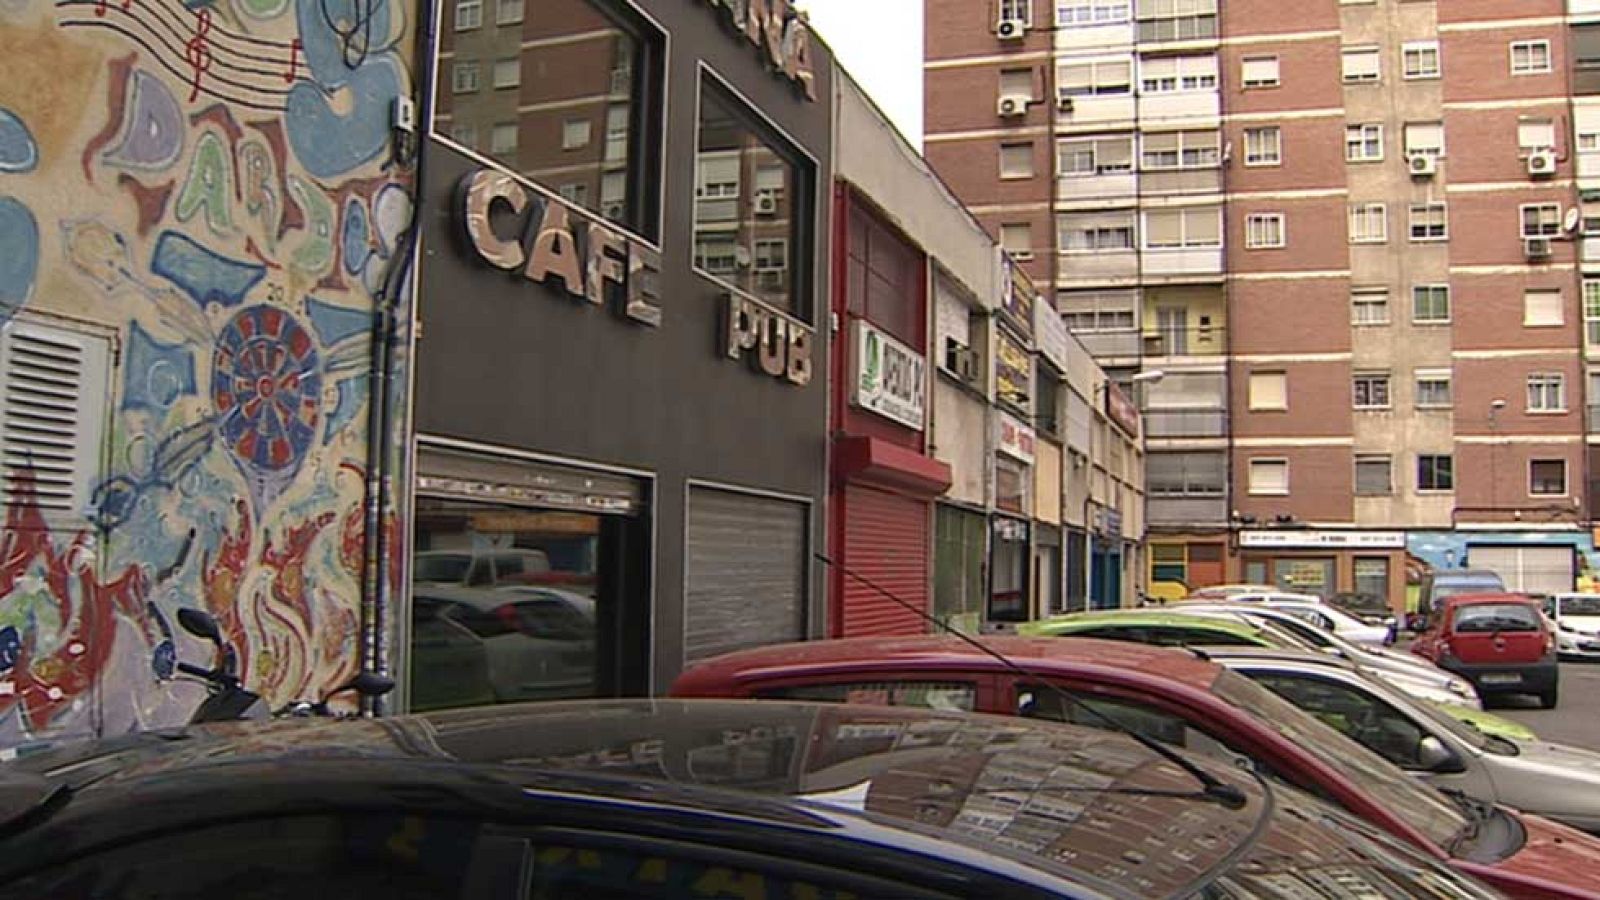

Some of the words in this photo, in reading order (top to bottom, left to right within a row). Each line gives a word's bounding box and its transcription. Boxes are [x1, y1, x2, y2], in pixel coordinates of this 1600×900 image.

[267, 283, 285, 302] 20
[458, 170, 662, 327] CAFE
[722, 292, 813, 386] PUB
